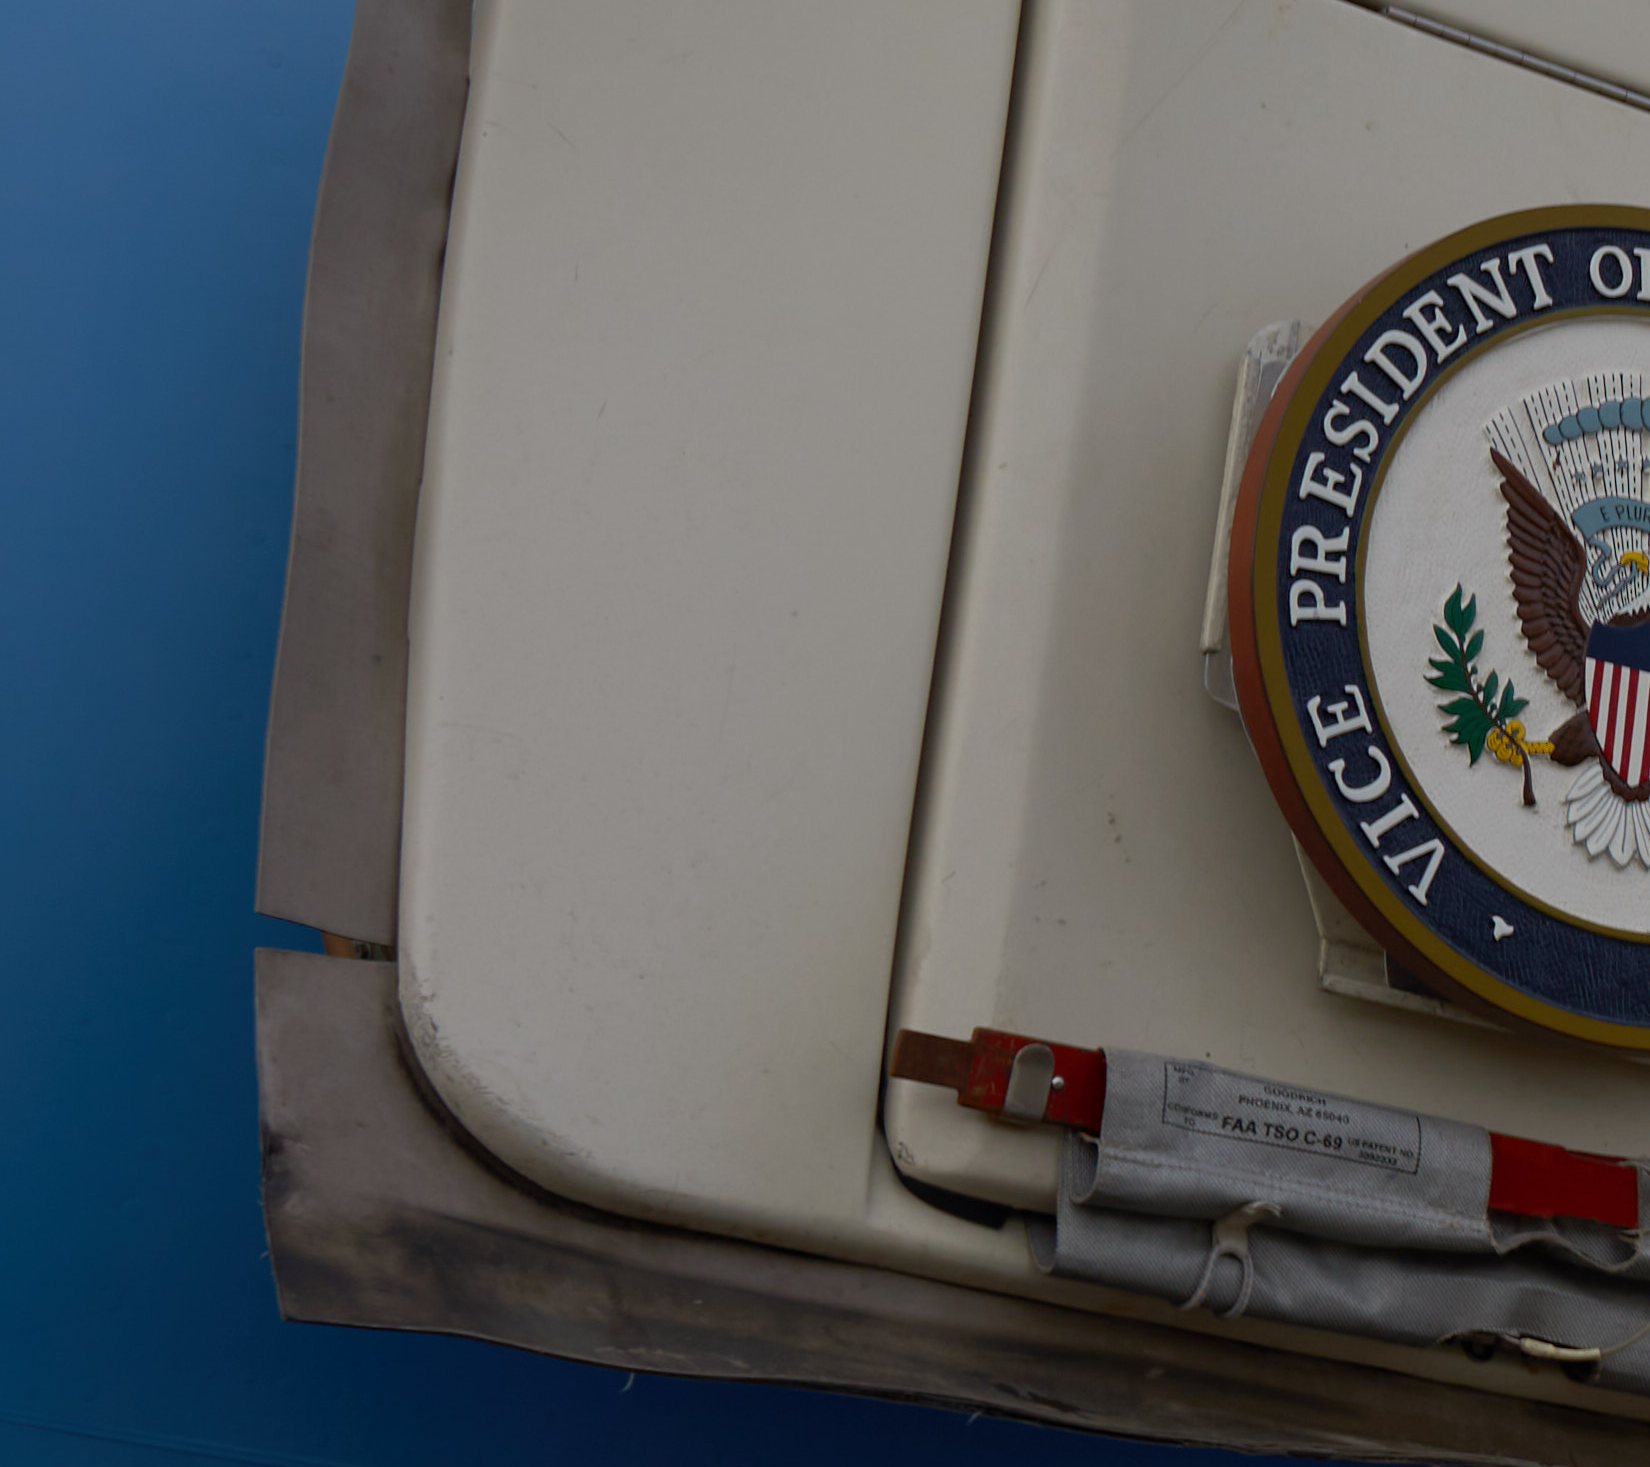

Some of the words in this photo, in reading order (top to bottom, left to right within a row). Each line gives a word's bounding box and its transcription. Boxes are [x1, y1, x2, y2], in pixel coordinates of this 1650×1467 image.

[1289, 243, 1556, 628] PRESIDENT
[1599, 506, 1611, 523] E
[1308, 684, 1449, 907] VICE
[1296, 1104, 1313, 1118] AZ
[1221, 1116, 1257, 1135] FAA
[1263, 1123, 1299, 1142] TSO
[1303, 1131, 1344, 1150] C-69
